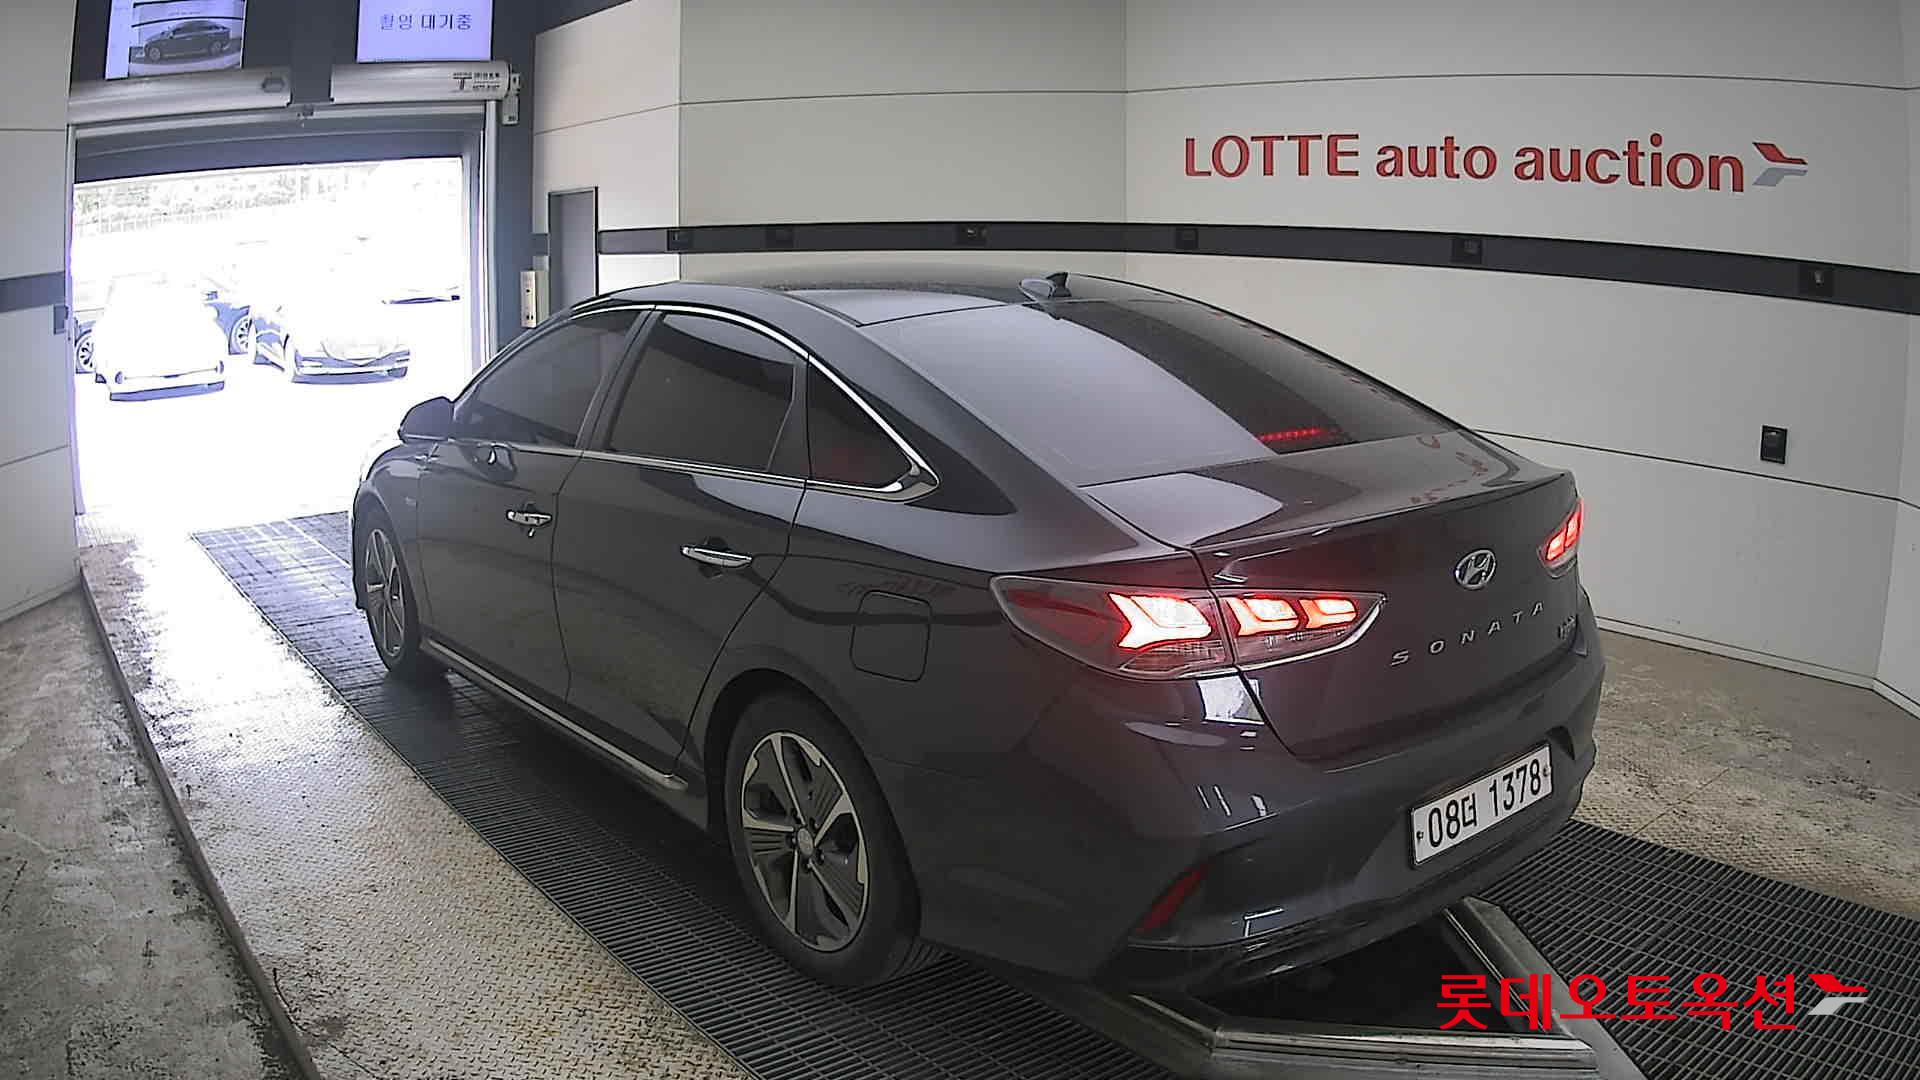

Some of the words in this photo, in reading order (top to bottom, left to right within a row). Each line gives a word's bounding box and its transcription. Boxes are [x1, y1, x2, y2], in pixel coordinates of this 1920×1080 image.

[420, 13, 472, 31] 대기중
[1184, 133, 1360, 177] LOTTE
[1376, 135, 1497, 180] auto
[1513, 132, 1744, 193] auction
[1391, 601, 1544, 667] SONATA
[1428, 792, 1478, 848] 08더
[1488, 758, 1541, 817] 1378
